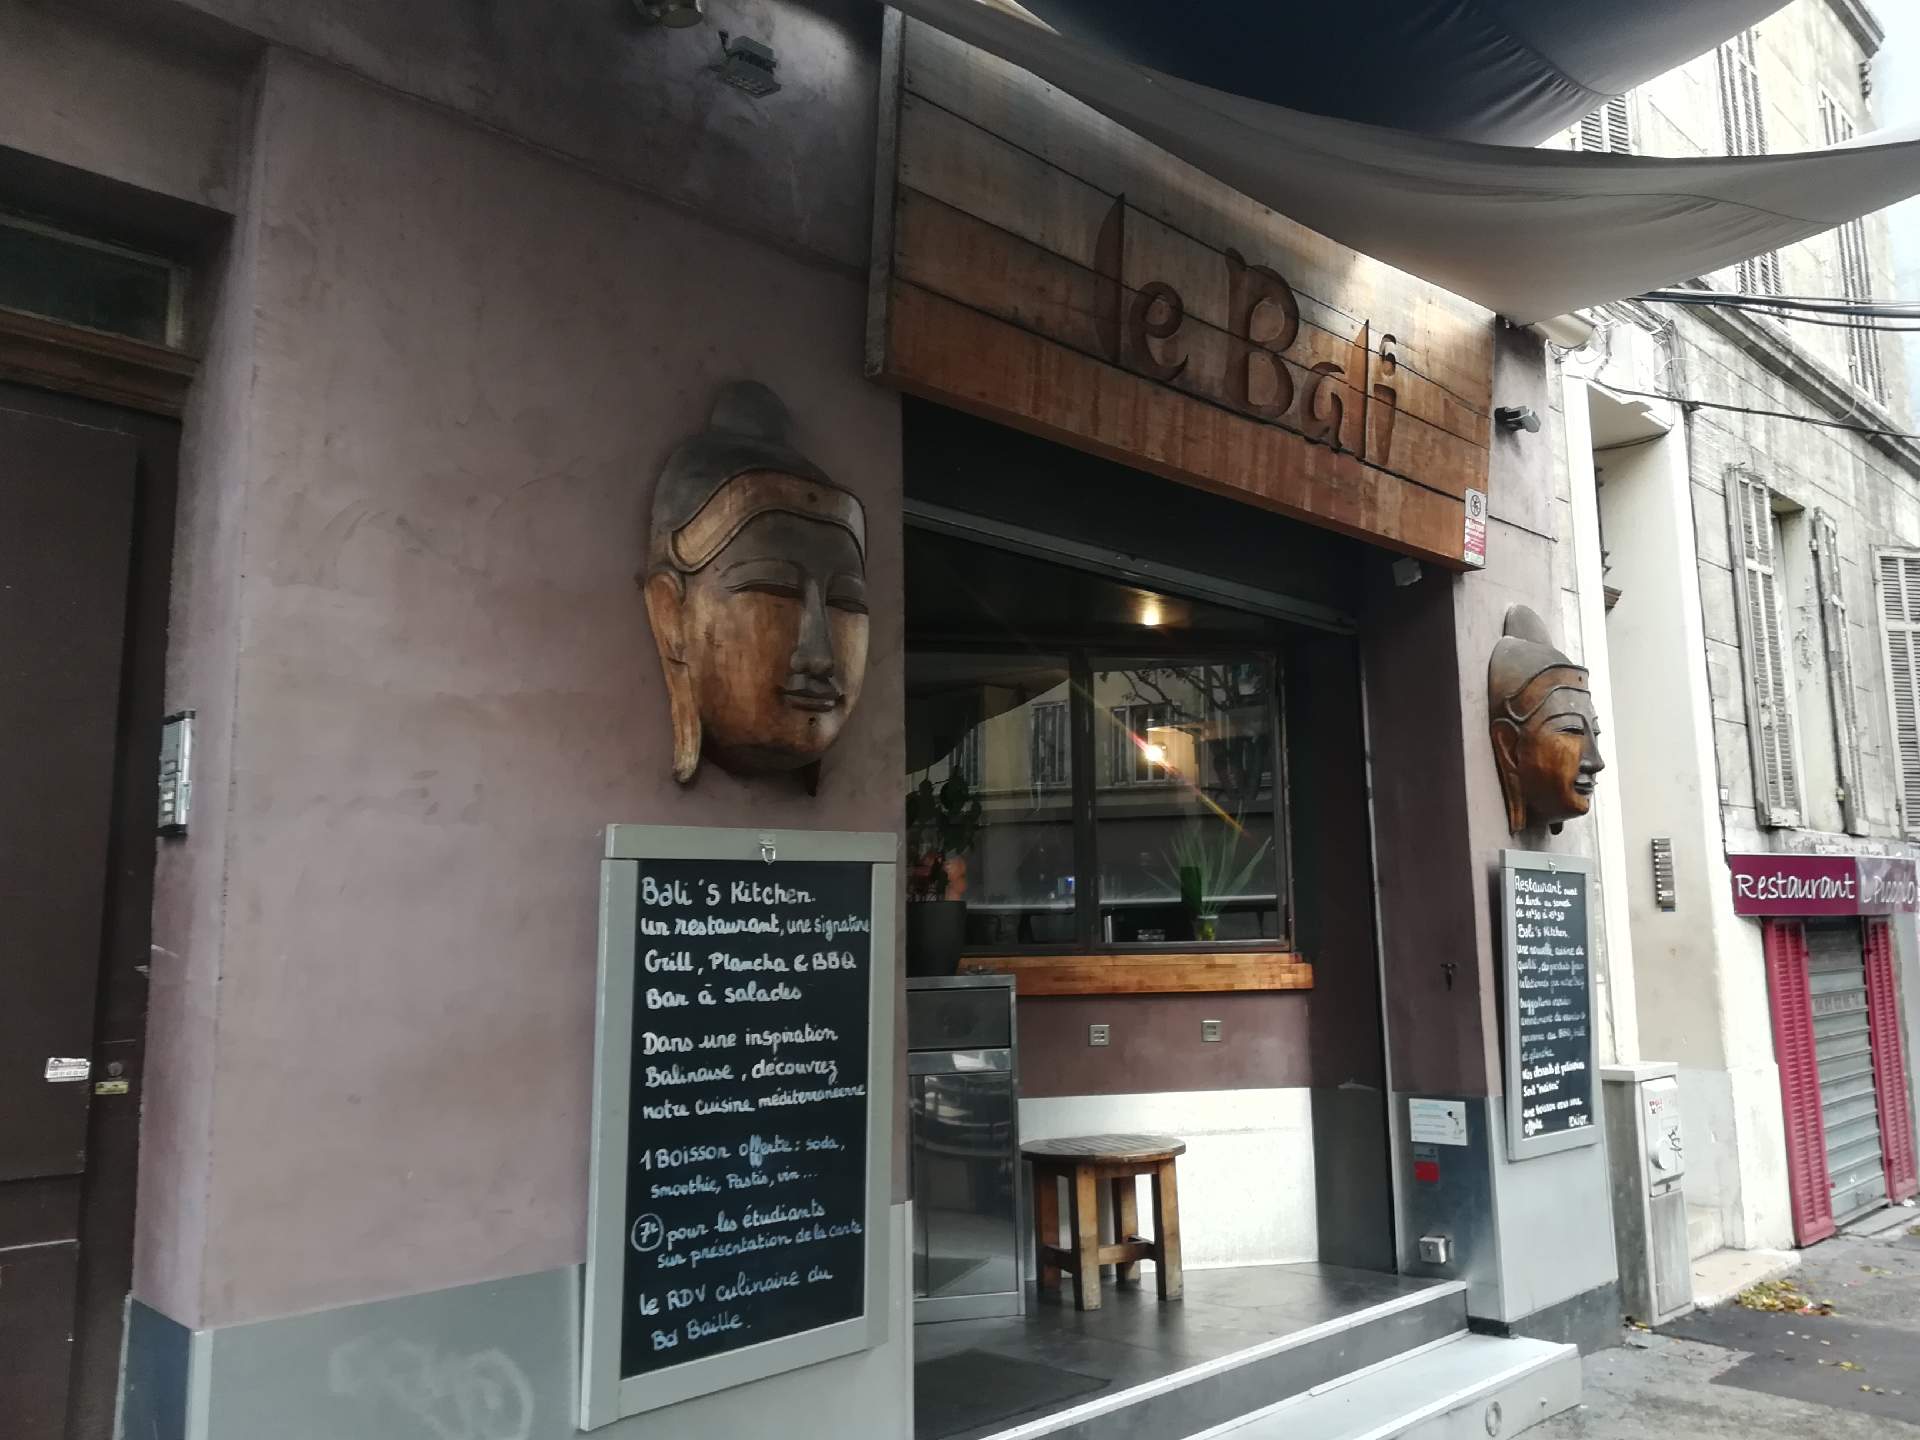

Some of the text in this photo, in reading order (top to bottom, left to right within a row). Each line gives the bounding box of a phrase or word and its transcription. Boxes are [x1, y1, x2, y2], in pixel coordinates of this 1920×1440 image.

[1735, 872, 1855, 900] Restaurant
[787, 919, 812, 934] une
[708, 952, 789, 972] Plancha
[812, 951, 857, 971] BBQ
[646, 988, 689, 1009] Bar
[725, 981, 802, 1003] salades
[642, 1023, 838, 1055] Dans une inspiration
[752, 1056, 840, 1085] découvrez
[643, 1100, 690, 1120] notre
[666, 1224, 709, 1251] pour
[714, 1210, 738, 1232] les
[742, 1198, 825, 1228] étudiants
[689, 1233, 791, 1268] présentation
[667, 1284, 706, 1310] RDV
[715, 1271, 800, 1302] culinaire
[807, 1265, 833, 1283] du
[651, 1329, 678, 1350] Bd
